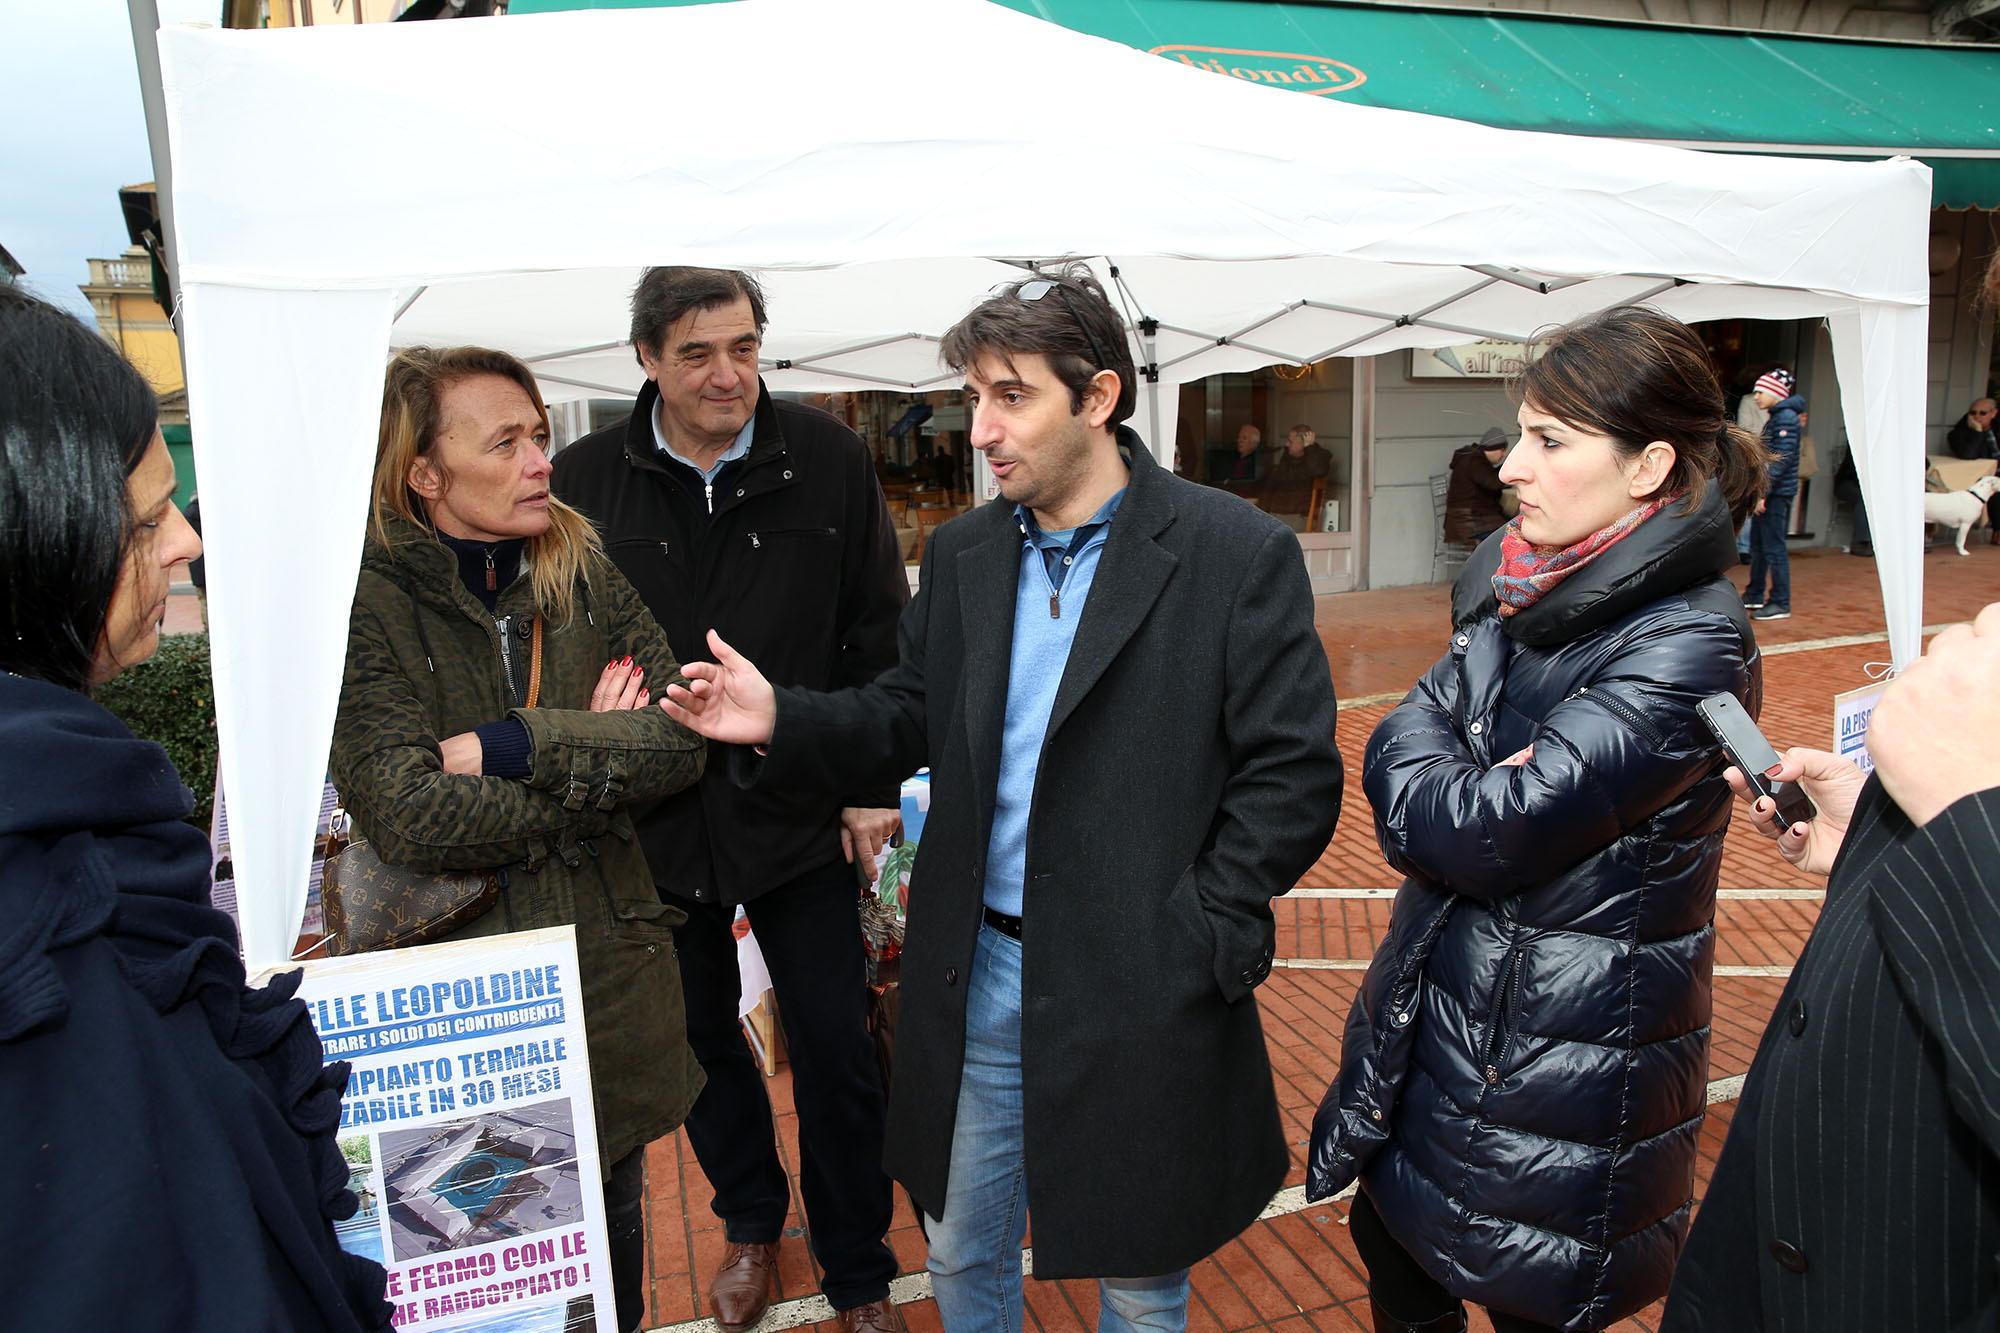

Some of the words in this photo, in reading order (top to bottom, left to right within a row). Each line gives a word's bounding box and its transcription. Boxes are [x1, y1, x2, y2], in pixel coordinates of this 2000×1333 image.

[1841, 716, 1851, 736] LA
[376, 964, 562, 1023] LEOPOLDINE
[370, 1033, 376, 1047] I
[379, 1028, 424, 1047] SOLDI
[427, 1020, 452, 1038] DEI
[455, 1002, 562, 1034] CONTRIBUENTI
[458, 1037, 567, 1079] TERMALE
[429, 1085, 455, 1114] IN
[461, 1079, 495, 1108] 30
[501, 1066, 561, 1100] MESI
[409, 1252, 496, 1292] FERMO
[503, 1238, 555, 1272] CON
[561, 1231, 587, 1259] LE
[424, 1265, 578, 1320] RADDOPPIATO
